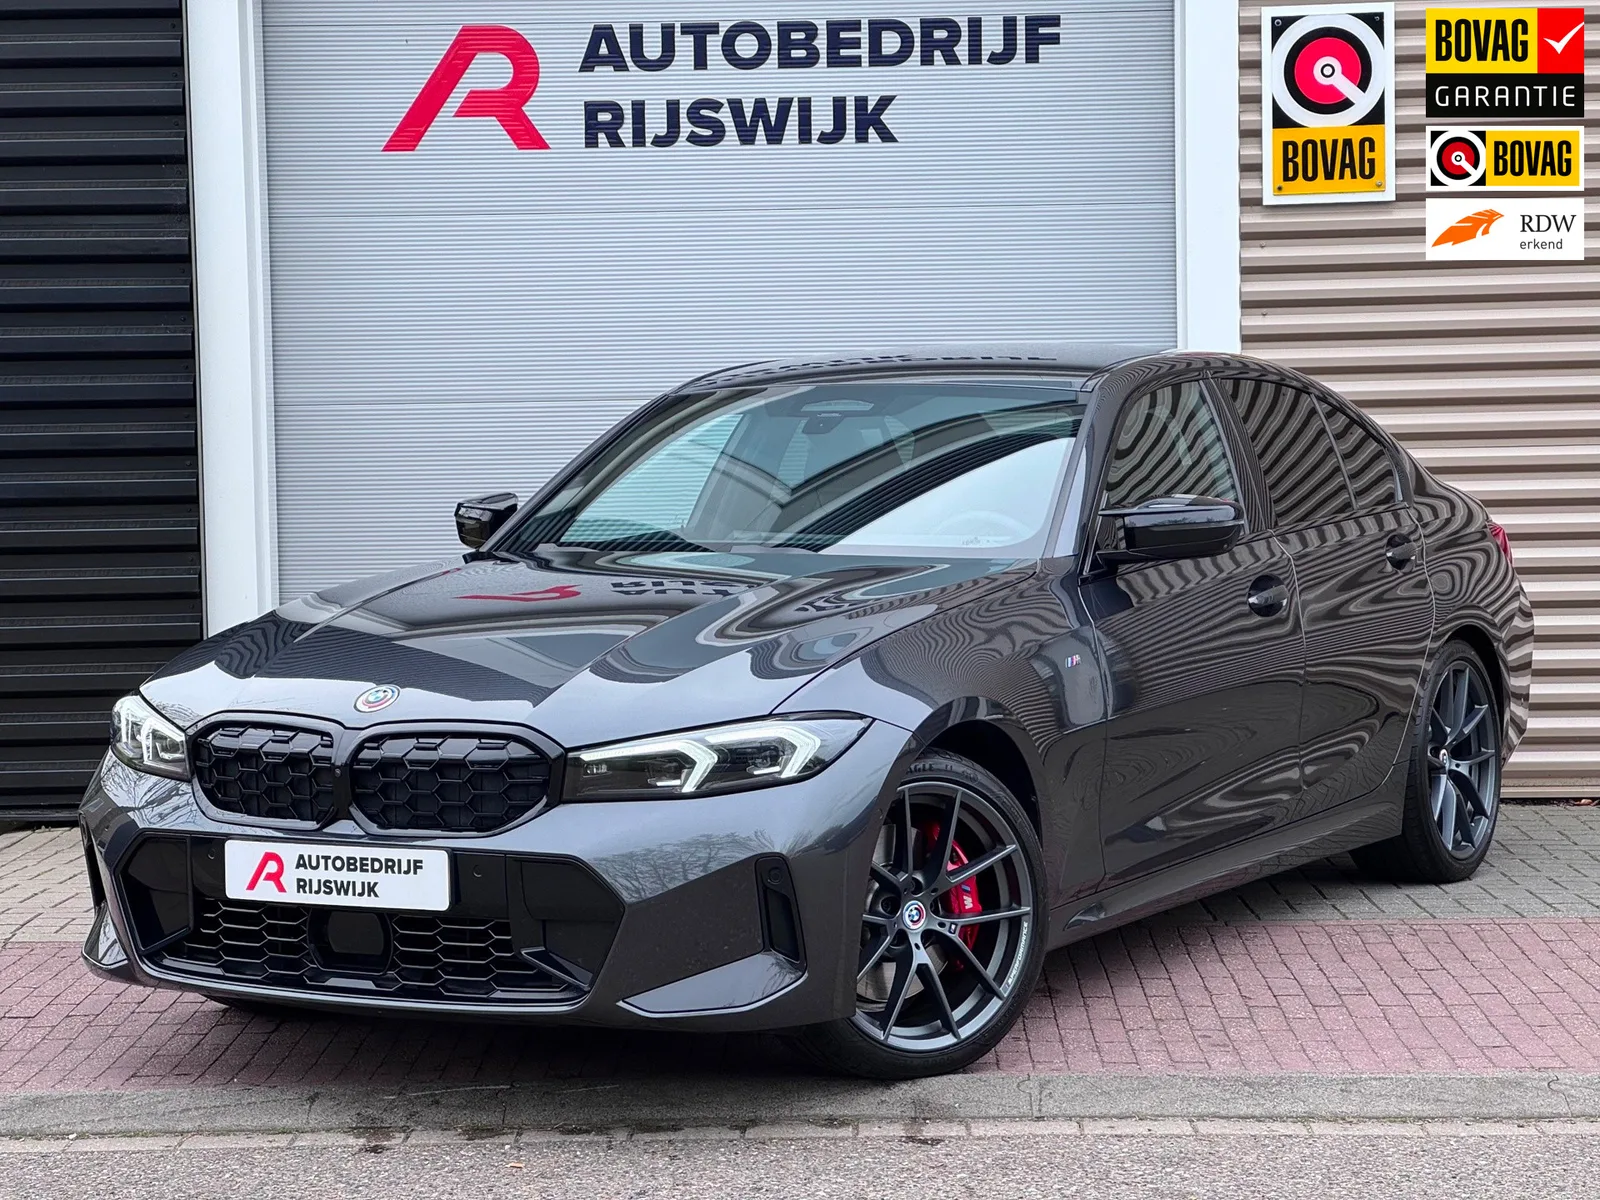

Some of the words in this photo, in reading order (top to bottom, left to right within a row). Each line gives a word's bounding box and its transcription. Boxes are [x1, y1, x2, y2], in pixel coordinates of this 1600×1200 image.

[578, 14, 1062, 73] AUTOBEDRIJF
[583, 94, 898, 149] RIJSWIJK
[1282, 136, 1376, 182] BOVAG
[295, 853, 424, 876] AUTOBEDRIJF
[296, 877, 380, 898] RIJSWIJK
